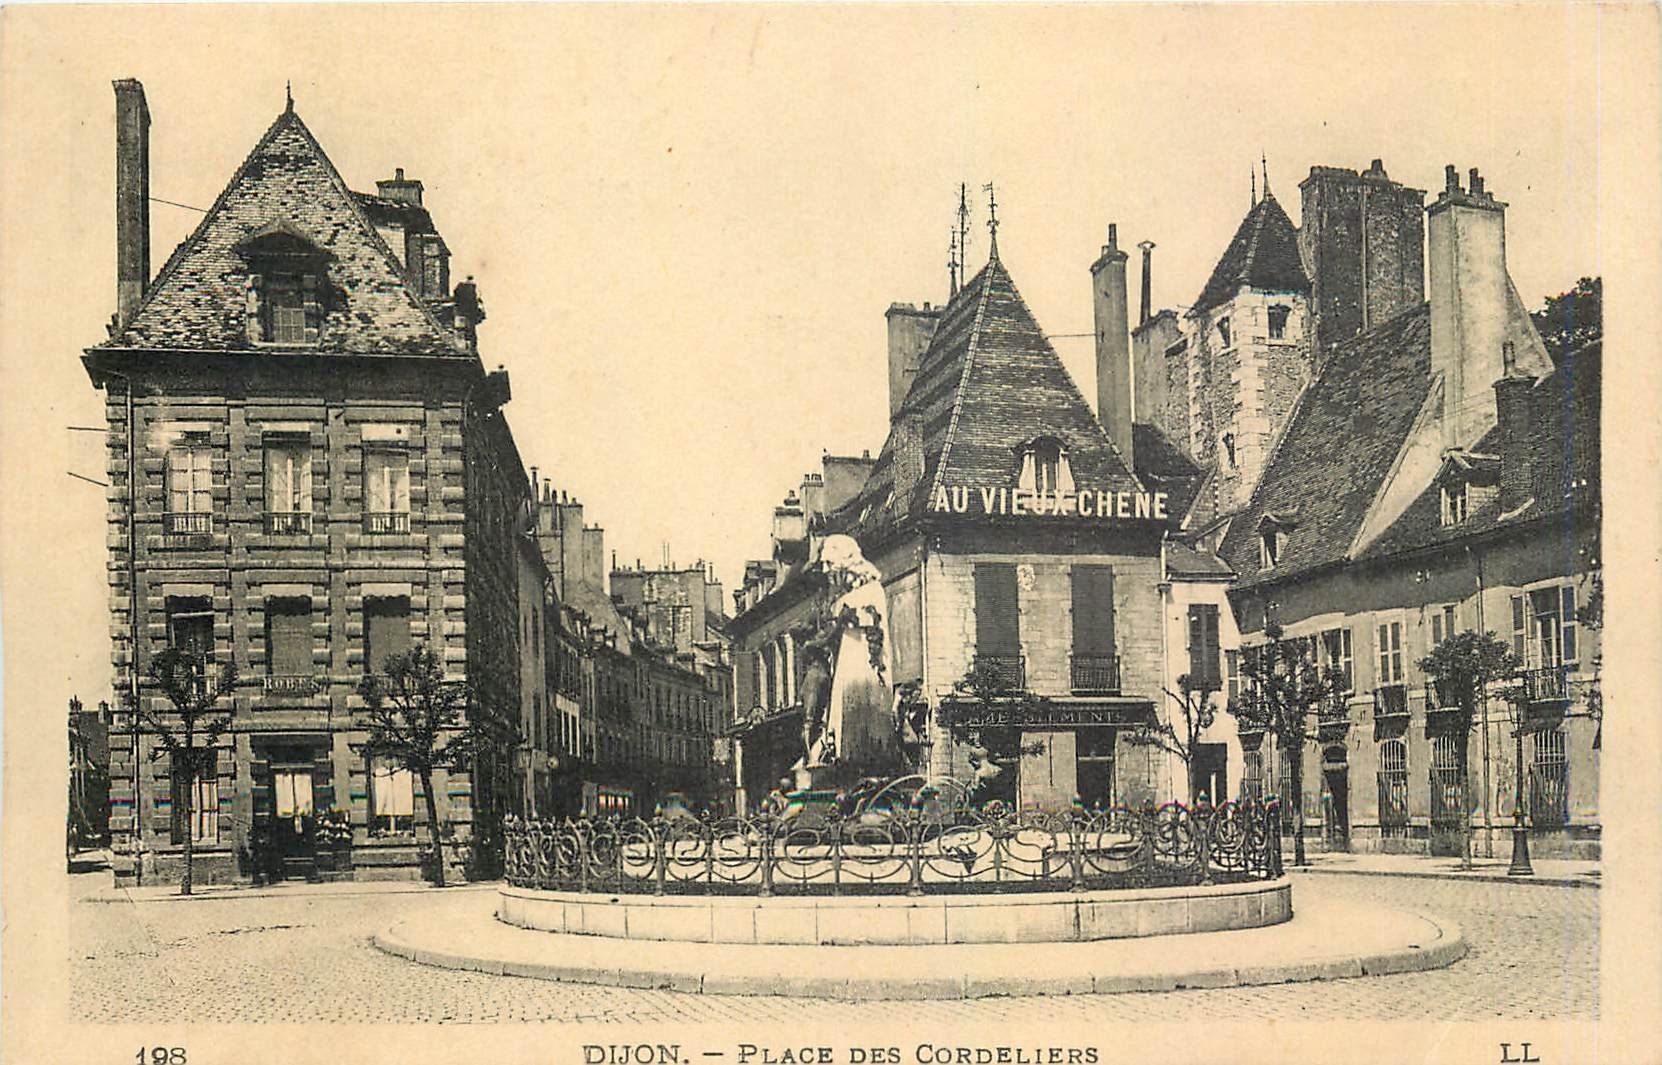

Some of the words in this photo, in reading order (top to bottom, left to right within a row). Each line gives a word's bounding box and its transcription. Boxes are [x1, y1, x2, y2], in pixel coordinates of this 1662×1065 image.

[934, 484, 969, 513] AU
[981, 486, 1068, 516] VIEUX
[1077, 489, 1169, 520] CHENE
